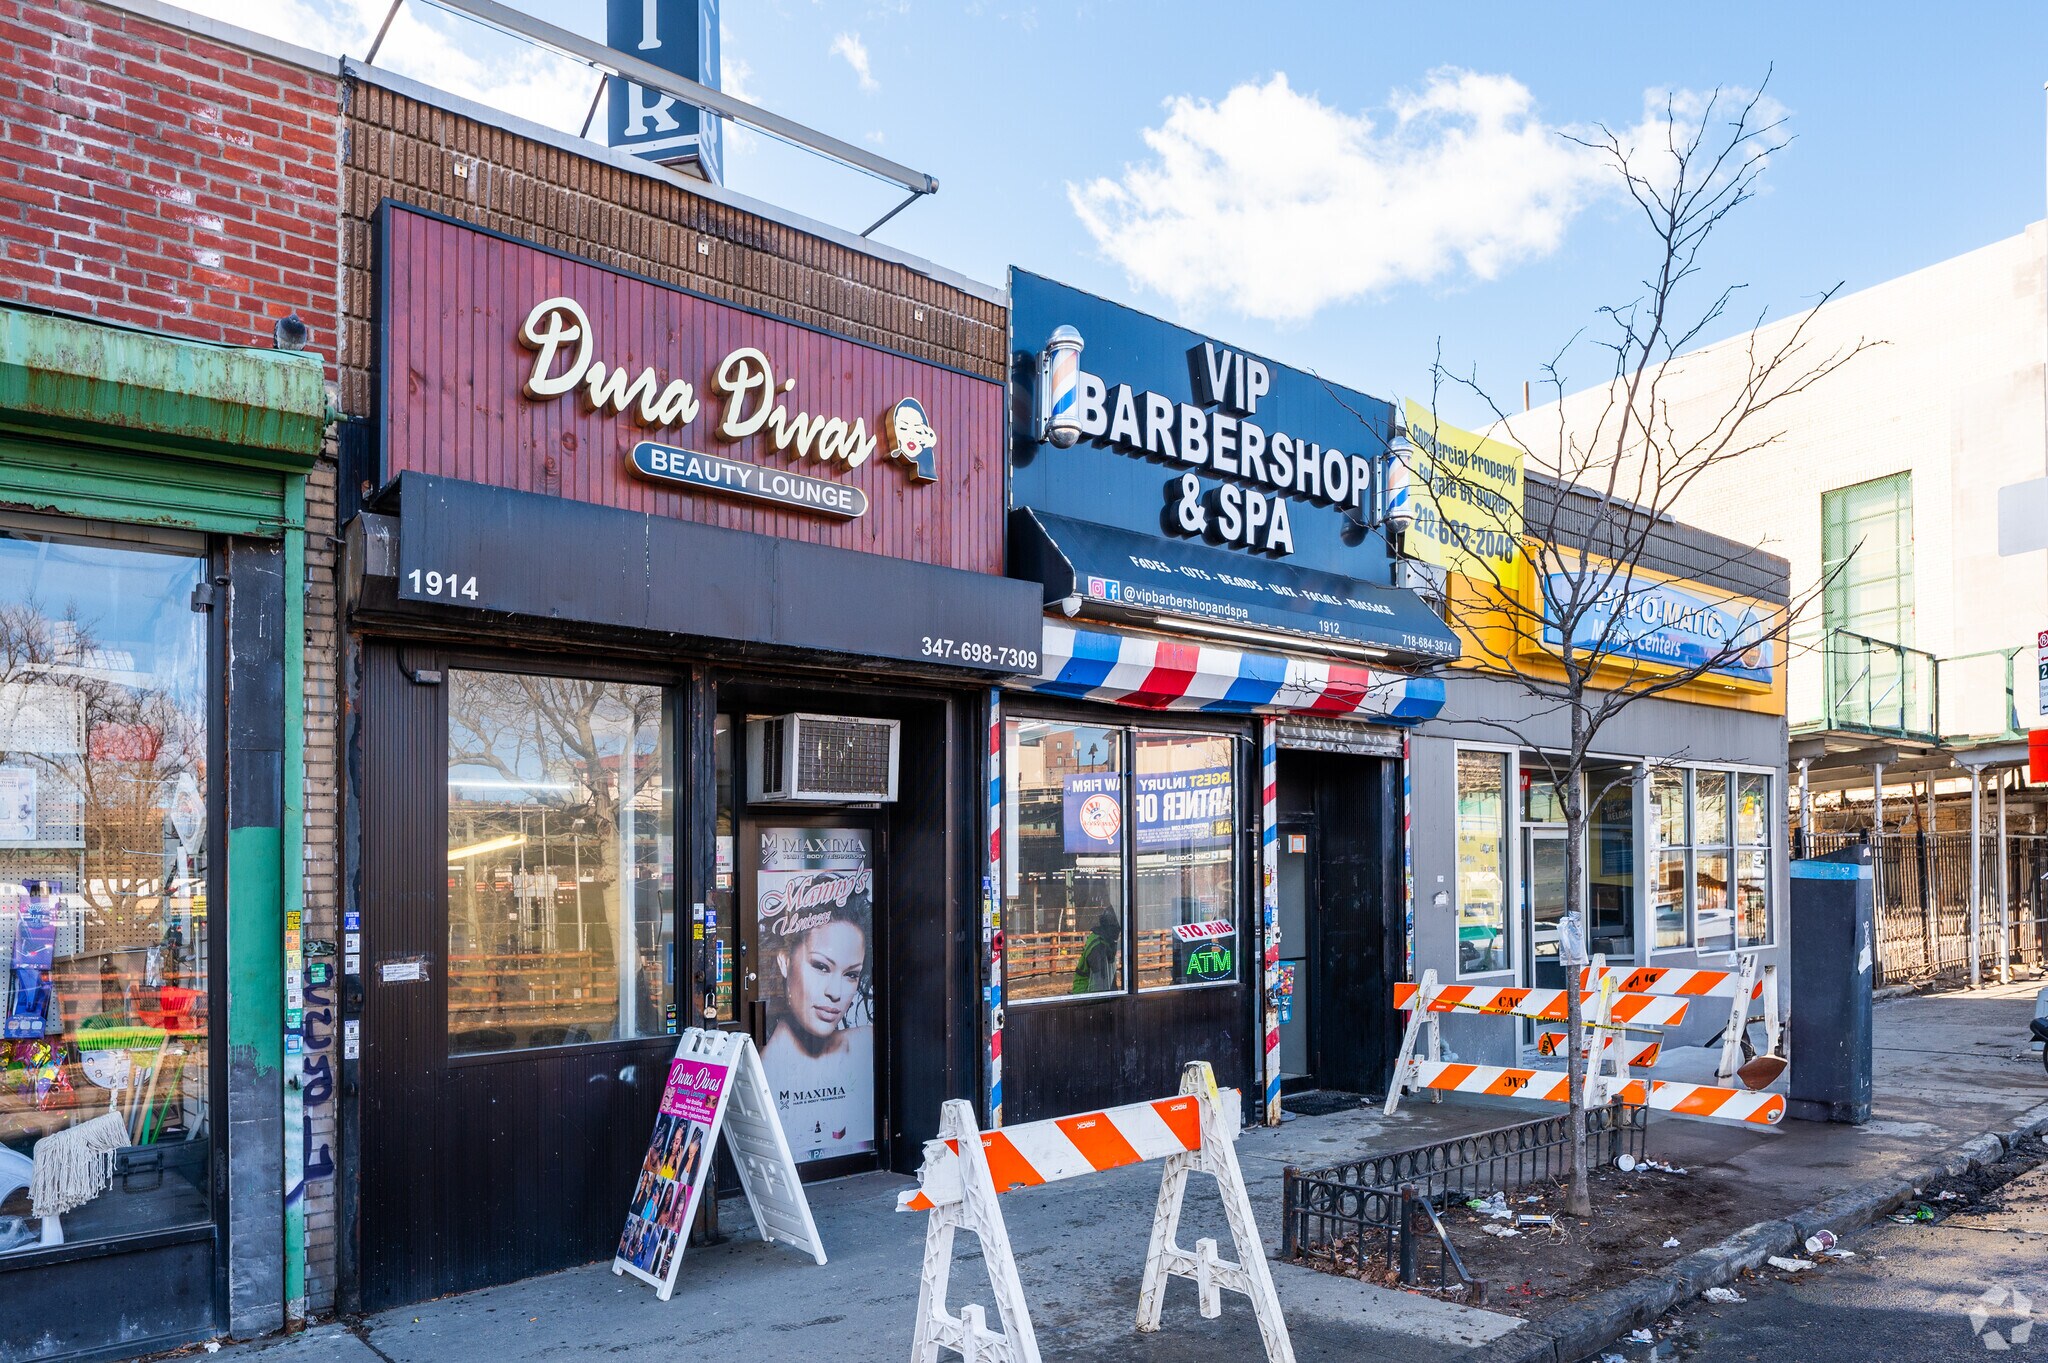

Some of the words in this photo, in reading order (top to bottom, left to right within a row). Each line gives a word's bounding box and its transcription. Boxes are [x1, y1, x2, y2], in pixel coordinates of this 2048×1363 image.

[1203, 341, 1271, 415] VIP
[713, 347, 878, 471] Divas
[1079, 370, 1370, 508] BARBERSHOP
[651, 449, 752, 489] BEAUTY
[757, 466, 853, 510] LOUNGE
[1472, 453, 1517, 486] Property
[1178, 473, 1207, 533] &
[1218, 483, 1295, 555] SPA
[408, 568, 479, 600] 1914
[1129, 555, 1172, 573] FADES
[1180, 565, 1211, 581] CUTS
[1217, 573, 1264, 591] BEARDS
[1124, 586, 1249, 619] @vipbarbershopandspa
[1319, 620, 1340, 634] 1912
[921, 636, 1038, 669] 347-698-7309
[1402, 634, 1453, 653] 718-684-3874
[1638, 628, 1681, 657] Centers
[782, 838, 867, 853] MAXIMA
[760, 860, 871, 917] Manny's
[1205, 921, 1233, 935] Bills
[1186, 950, 1231, 975] ATM
[1498, 996, 1524, 1008] CAC
[694, 1067, 722, 1092] Divas
[793, 1086, 846, 1101] MAXIMA
[1504, 1076, 1529, 1089] CAC
[1170, 1103, 1187, 1111] ROCK
[1077, 1120, 1096, 1129] ROCK
